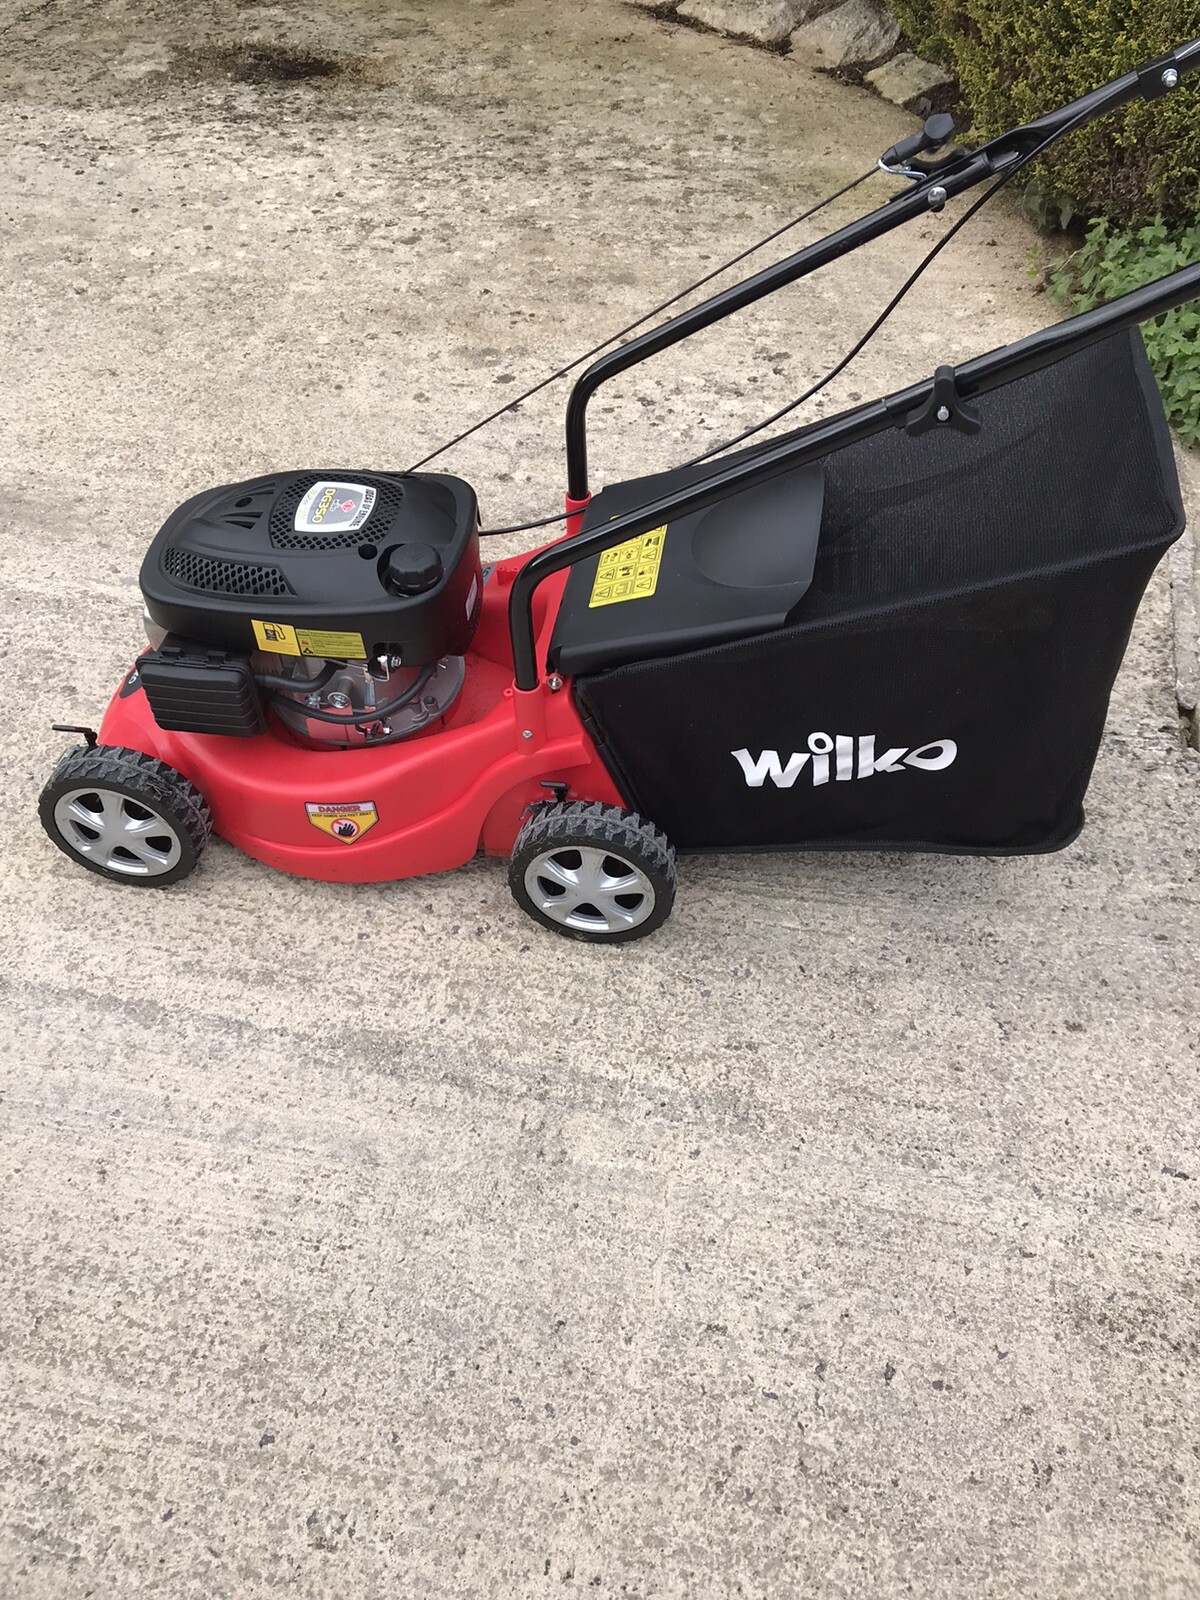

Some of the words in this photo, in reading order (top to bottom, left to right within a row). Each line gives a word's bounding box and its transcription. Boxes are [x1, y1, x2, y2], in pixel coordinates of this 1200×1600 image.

[311, 488, 337, 523] DG350
[349, 510, 369, 527] ENGINE
[730, 731, 958, 789] wilko
[317, 805, 361, 813] DANGER
